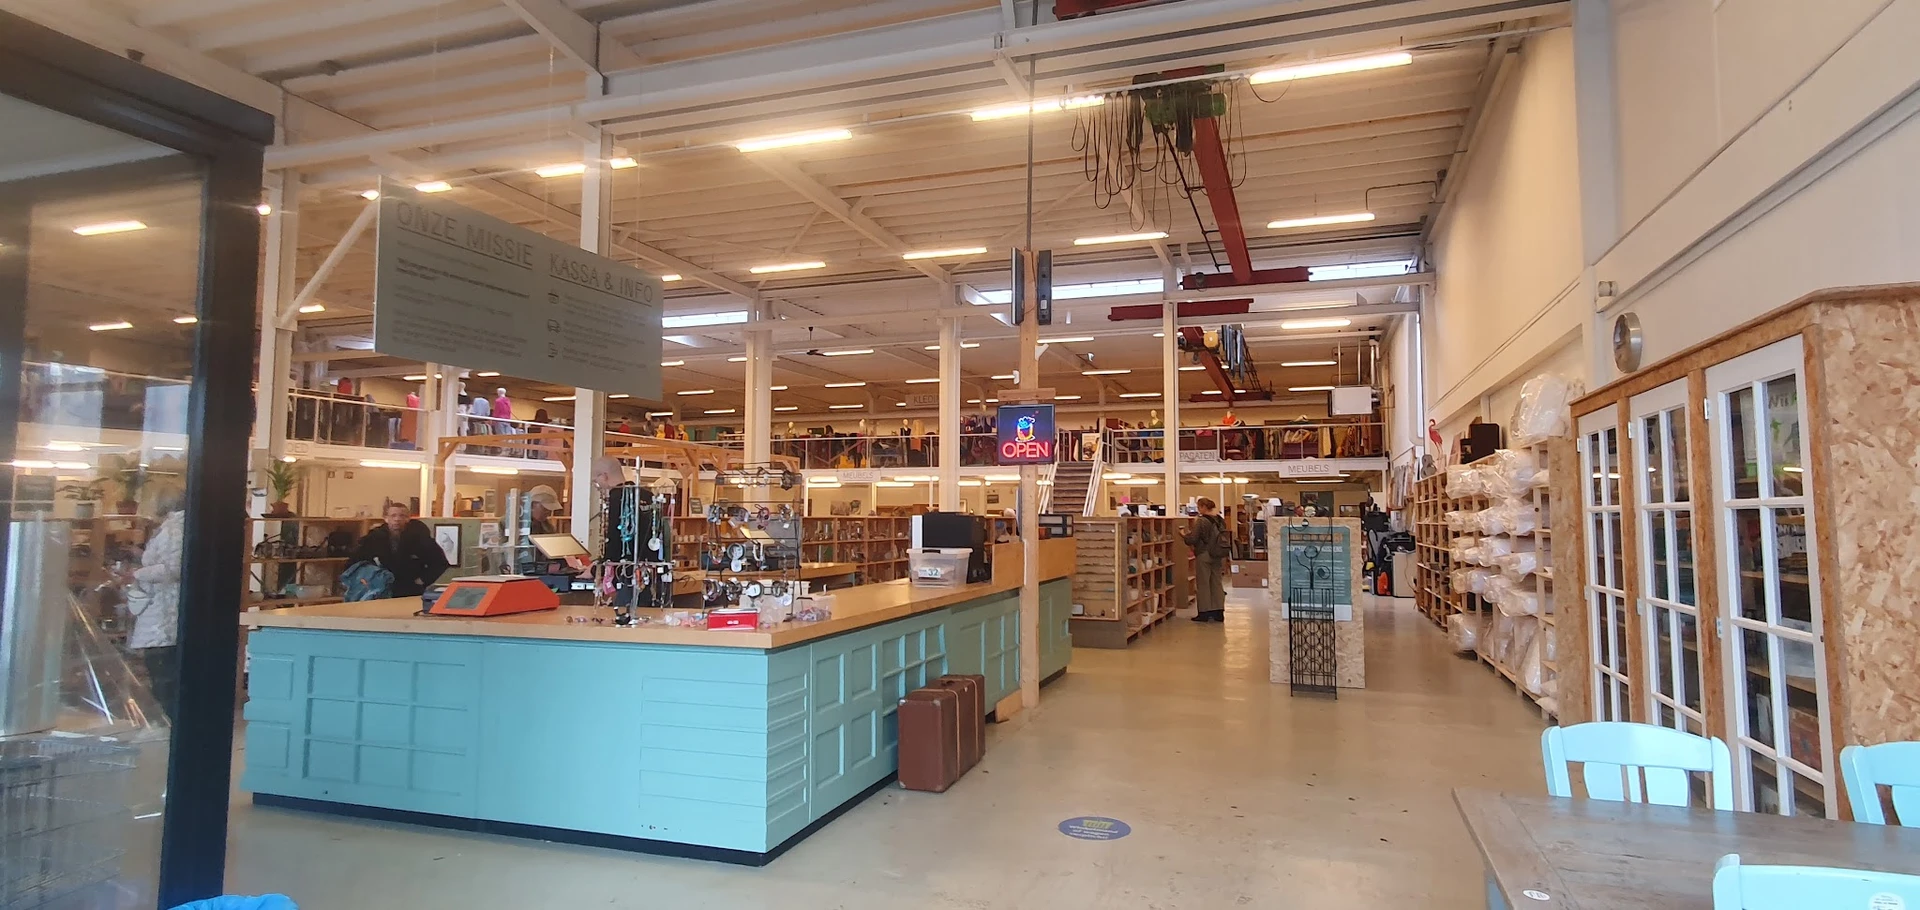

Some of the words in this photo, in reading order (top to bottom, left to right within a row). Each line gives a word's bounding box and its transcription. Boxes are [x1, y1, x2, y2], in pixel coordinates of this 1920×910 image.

[397, 201, 457, 242] ONZE
[466, 225, 534, 267] MISSIE
[549, 252, 600, 287] KASSA
[604, 271, 613, 291] &
[620, 276, 653, 303] INFO
[1002, 442, 1049, 458] OPEN
[1287, 464, 1330, 473] MEUBELS
[840, 471, 874, 480] MEUBELS
[928, 568, 938, 576] 32
